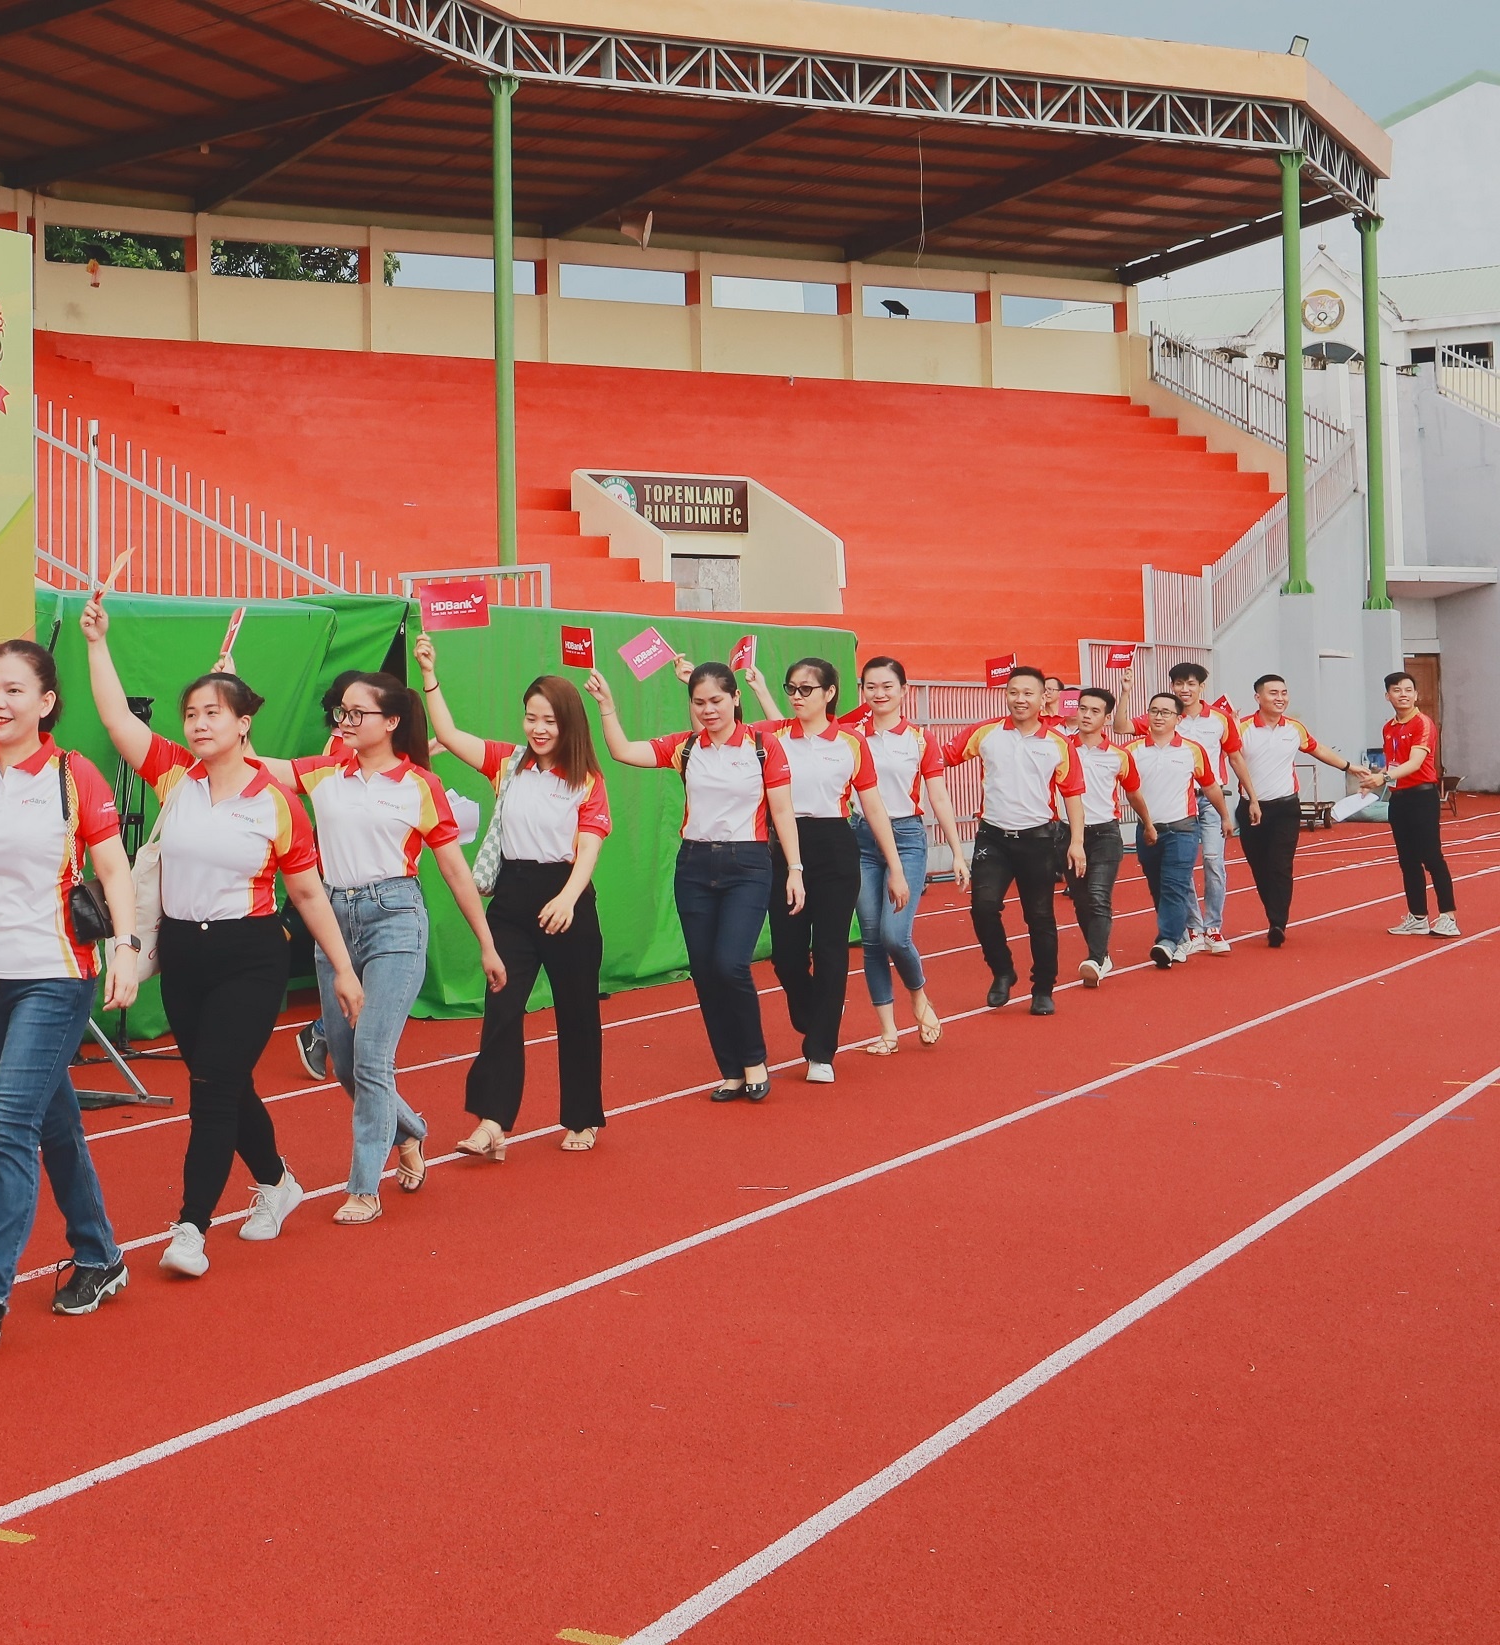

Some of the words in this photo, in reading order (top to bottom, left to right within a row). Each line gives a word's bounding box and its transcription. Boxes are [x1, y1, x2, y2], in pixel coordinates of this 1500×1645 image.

[643, 484, 734, 506] TOPENLAND
[644, 504, 681, 524] BINH
[684, 505, 721, 525] DINH
[724, 507, 742, 526] FC
[430, 599, 473, 612] HDBank
[564, 640, 584, 652] HDBank
[632, 644, 660, 666] HDBank
